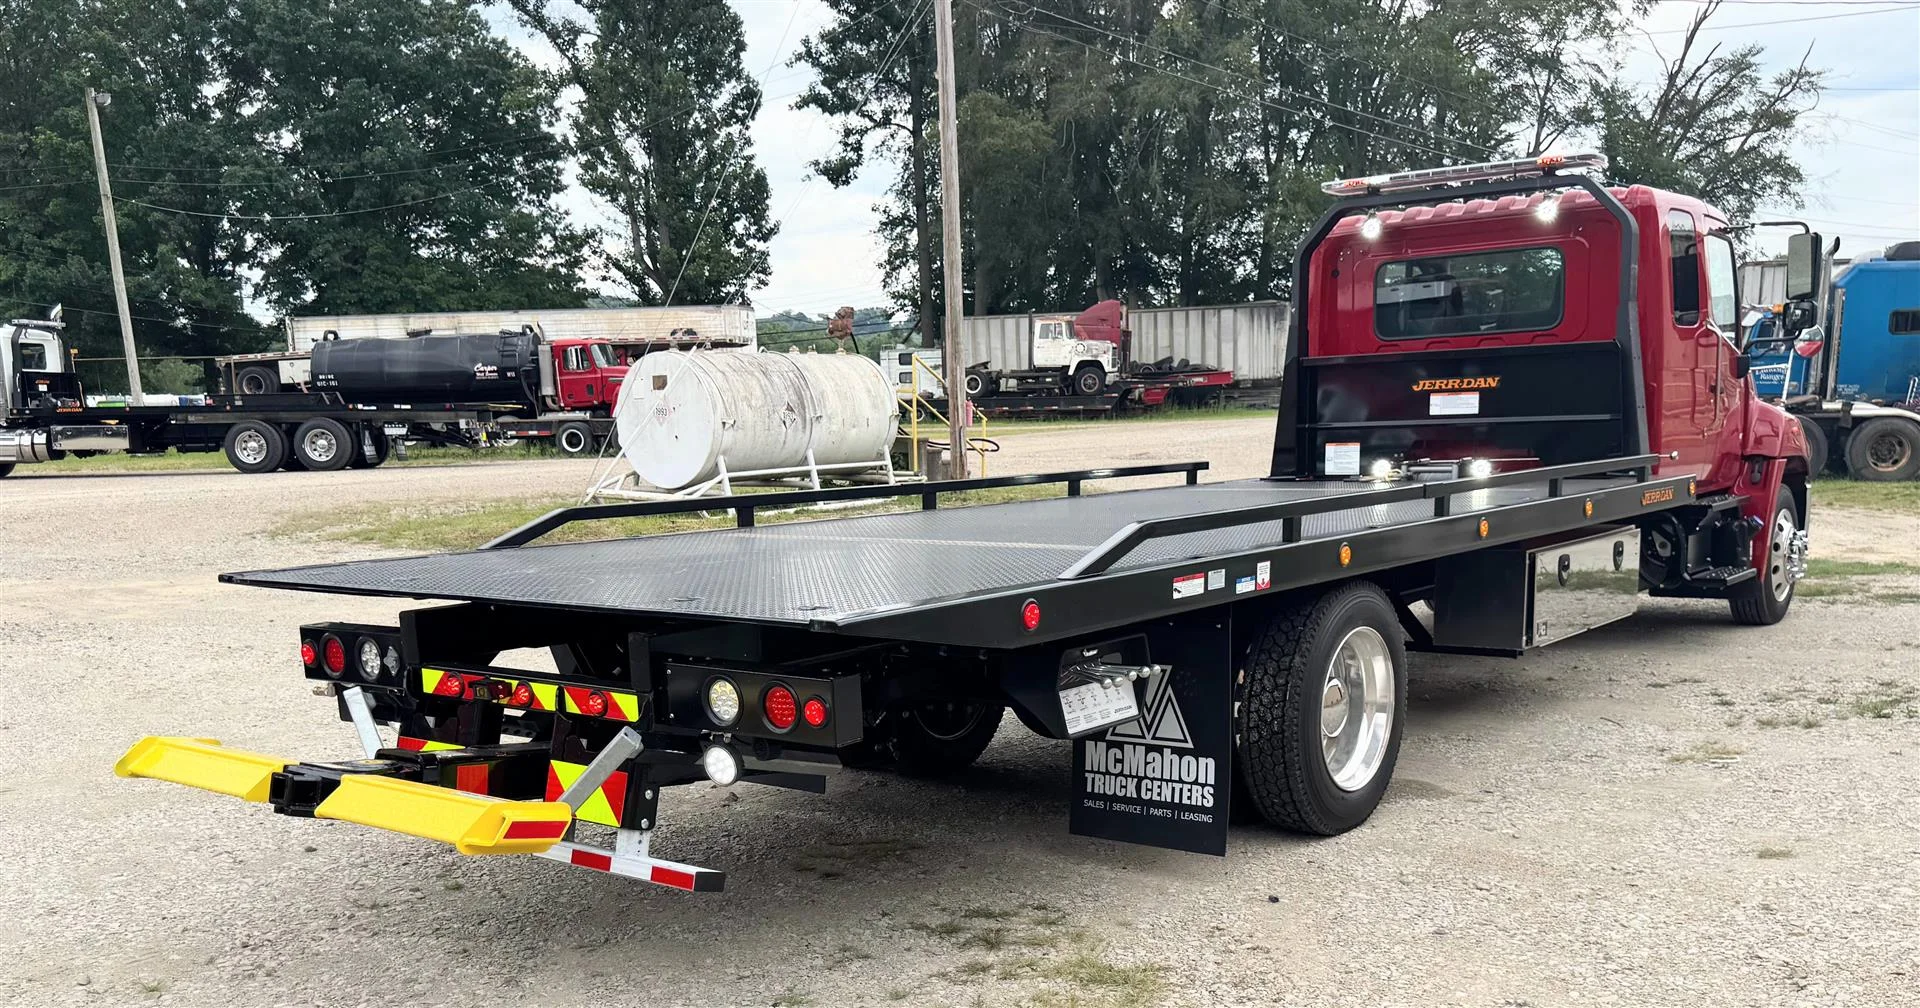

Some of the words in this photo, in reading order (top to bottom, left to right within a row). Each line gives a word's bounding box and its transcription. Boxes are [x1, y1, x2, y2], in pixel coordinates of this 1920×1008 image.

[1085, 740, 1216, 785] McMahon
[1085, 772, 1138, 798] TRUCK
[1140, 779, 1214, 808] CENTERS
[1083, 799, 1105, 809] SALES
[1112, 802, 1142, 814] SERVICE
[1149, 807, 1172, 818] PARTS
[1180, 811, 1213, 823] LEASING
